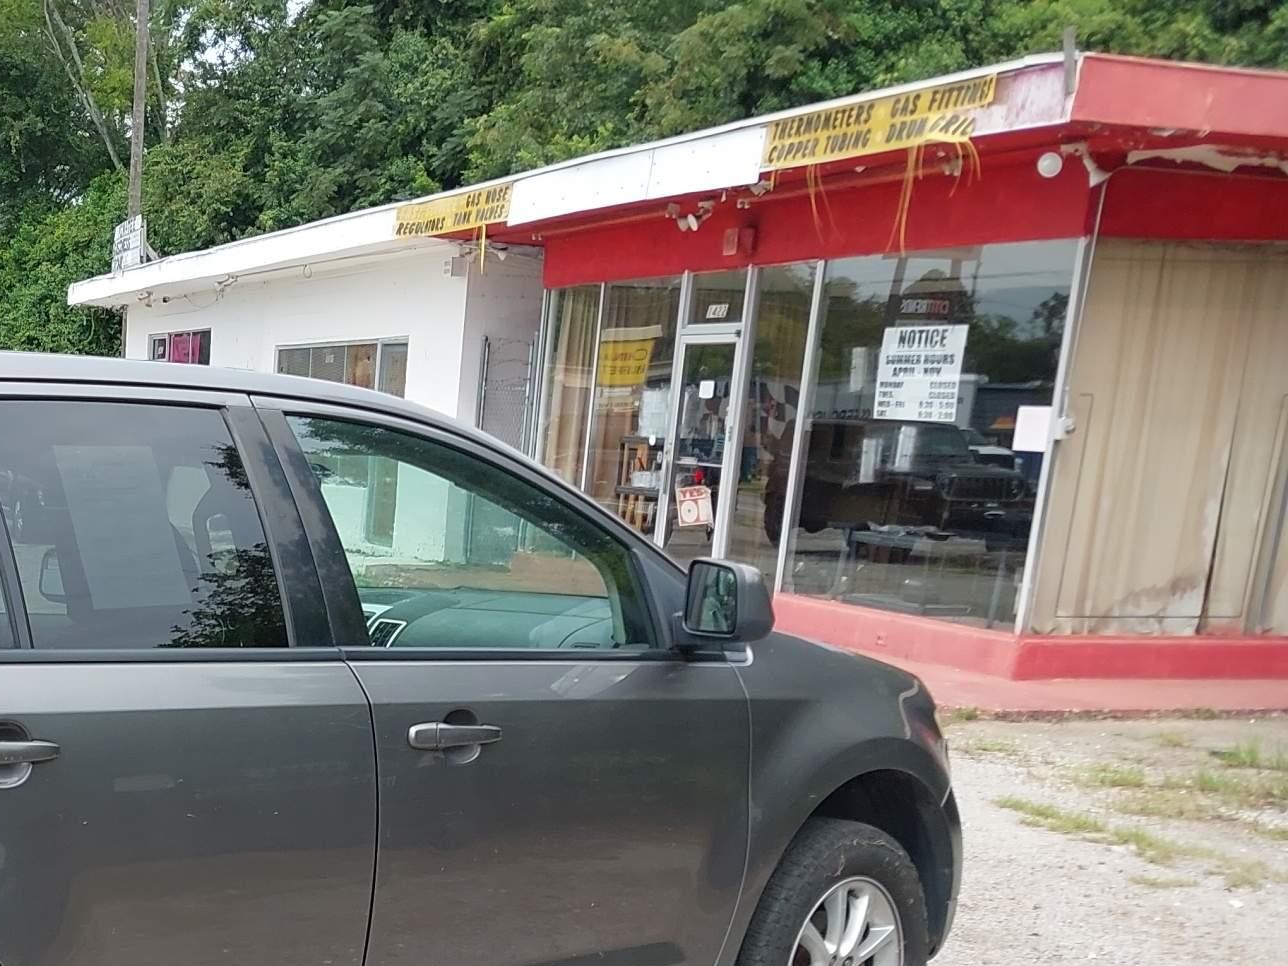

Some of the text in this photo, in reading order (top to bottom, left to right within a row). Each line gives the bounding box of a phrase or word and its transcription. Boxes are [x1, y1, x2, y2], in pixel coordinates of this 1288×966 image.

[772, 103, 875, 140] THERMOMETERS
[889, 93, 921, 119] GAS
[768, 138, 819, 164] COPPER
[824, 128, 872, 154] TUBING
[466, 186, 510, 209] GAS HOSE
[396, 204, 505, 236] REGULATORS TANK VALVES
[897, 328, 949, 349] NOTICE
[885, 353, 955, 365] SUMMER HOURS
